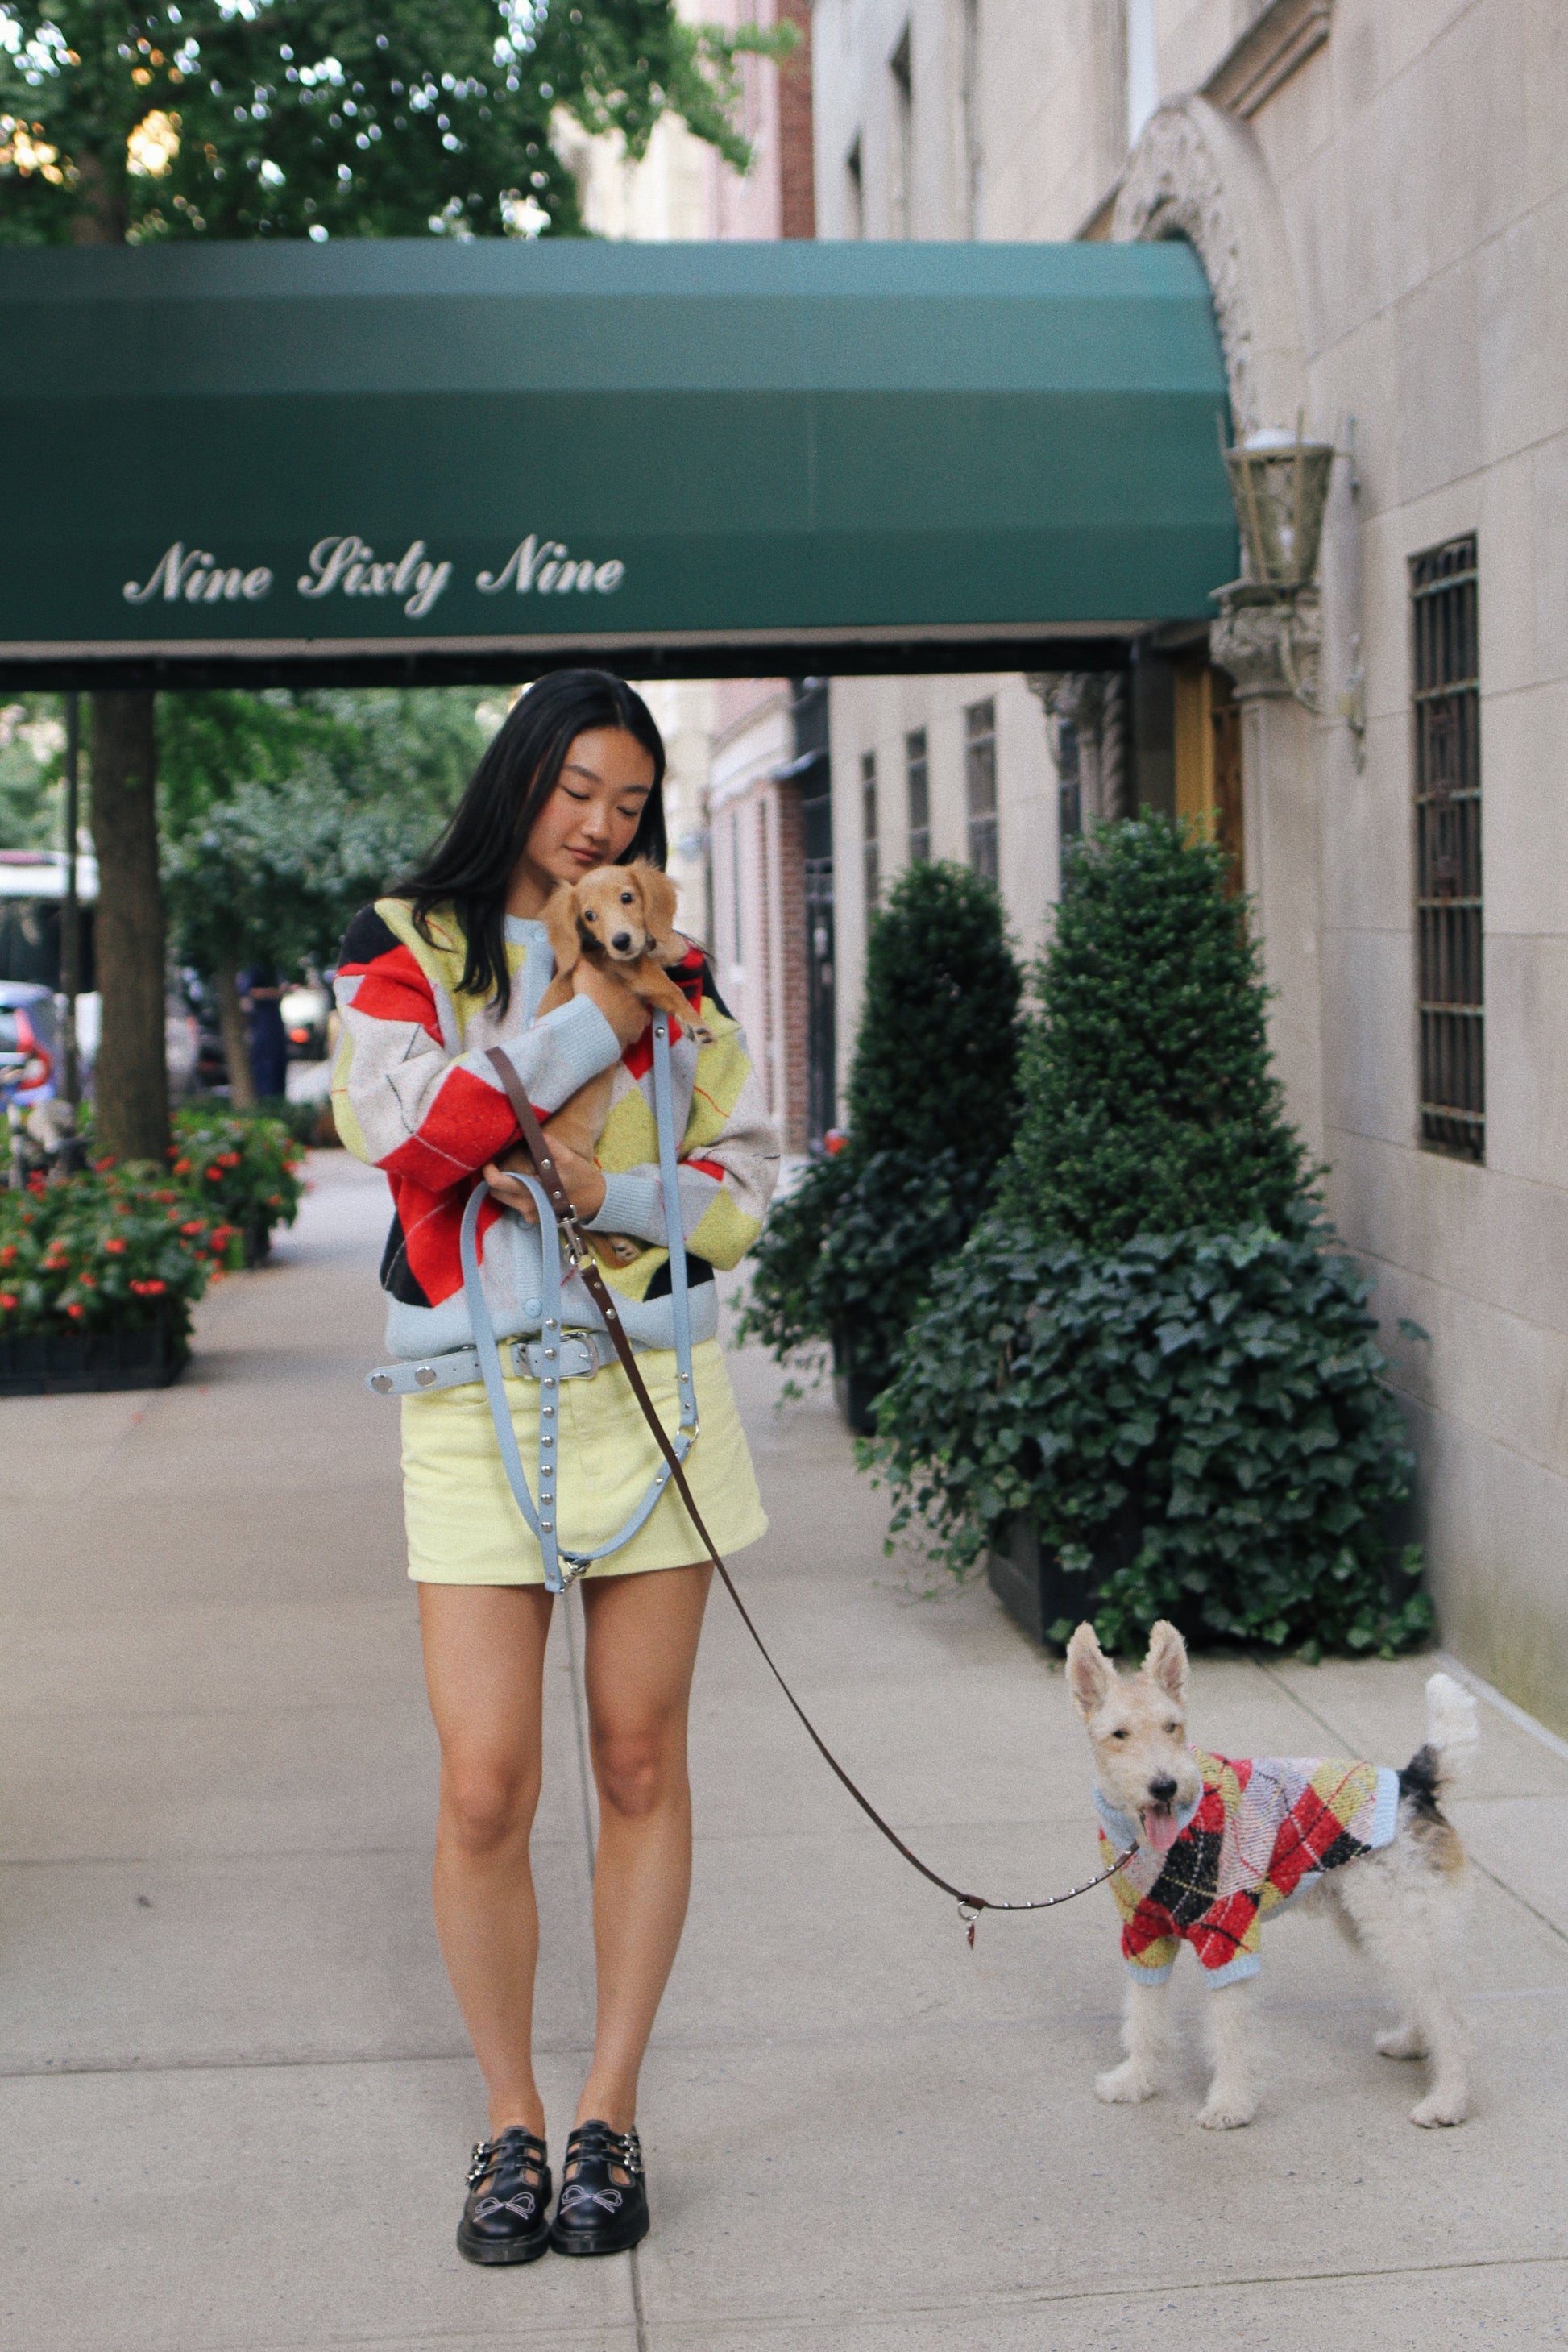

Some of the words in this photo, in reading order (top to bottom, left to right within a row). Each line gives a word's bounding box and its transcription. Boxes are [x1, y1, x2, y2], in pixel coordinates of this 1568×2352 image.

[122, 541, 273, 603] Nine
[297, 535, 453, 619] Sixty
[475, 533, 624, 595] Nine
